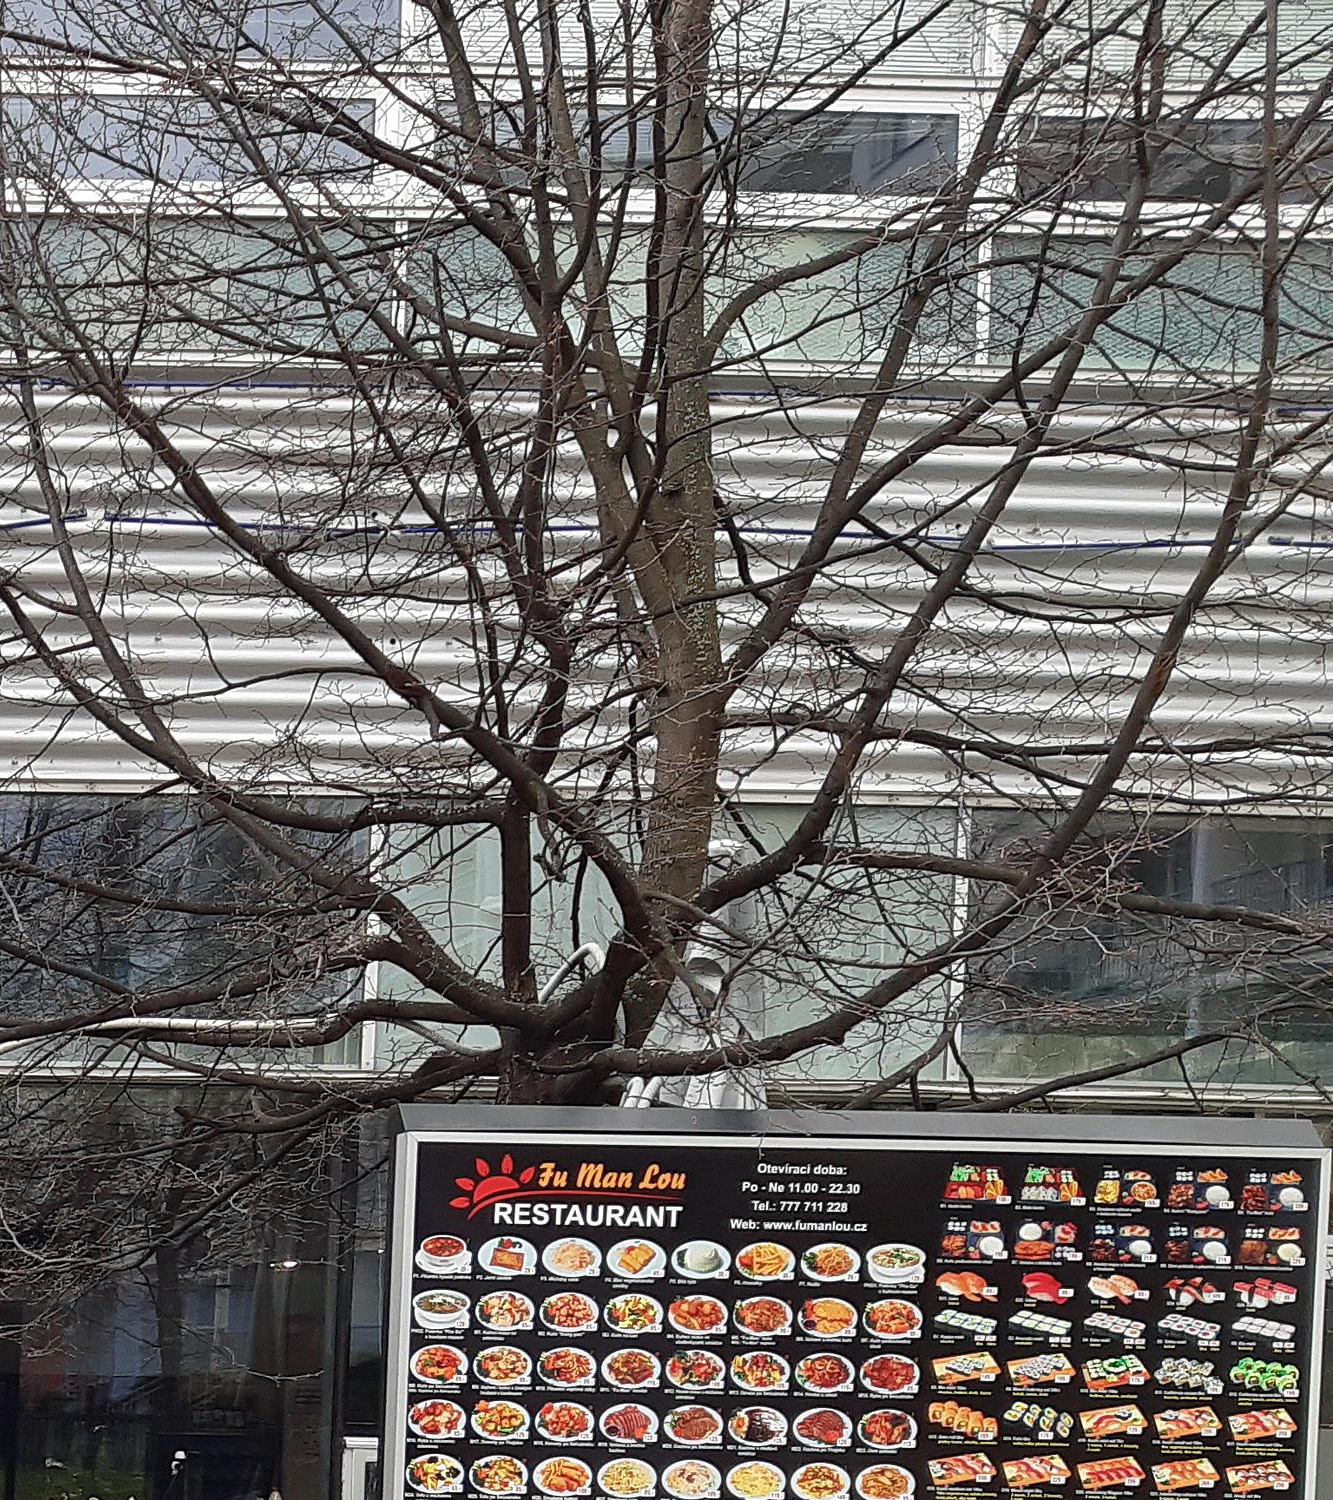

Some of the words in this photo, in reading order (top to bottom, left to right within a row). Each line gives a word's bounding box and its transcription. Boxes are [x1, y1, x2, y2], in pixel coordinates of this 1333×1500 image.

[538, 1162, 568, 1188] Fu
[576, 1163, 632, 1189] Man
[638, 1164, 686, 1191] Lou
[813, 1163, 848, 1176] doba:
[742, 1181, 759, 1193] Po
[768, 1182, 785, 1193] Ne
[788, 1182, 819, 1194] 11.00
[828, 1183, 861, 1195] 22.30
[751, 1200, 777, 1212] Tel.:
[779, 1201, 802, 1212] 777
[803, 1201, 824, 1213] 711
[826, 1202, 848, 1213] 228
[493, 1203, 684, 1228] RESTAURANT
[730, 1219, 760, 1231] Web:
[763, 1220, 868, 1233] www.fumanlou.cz
